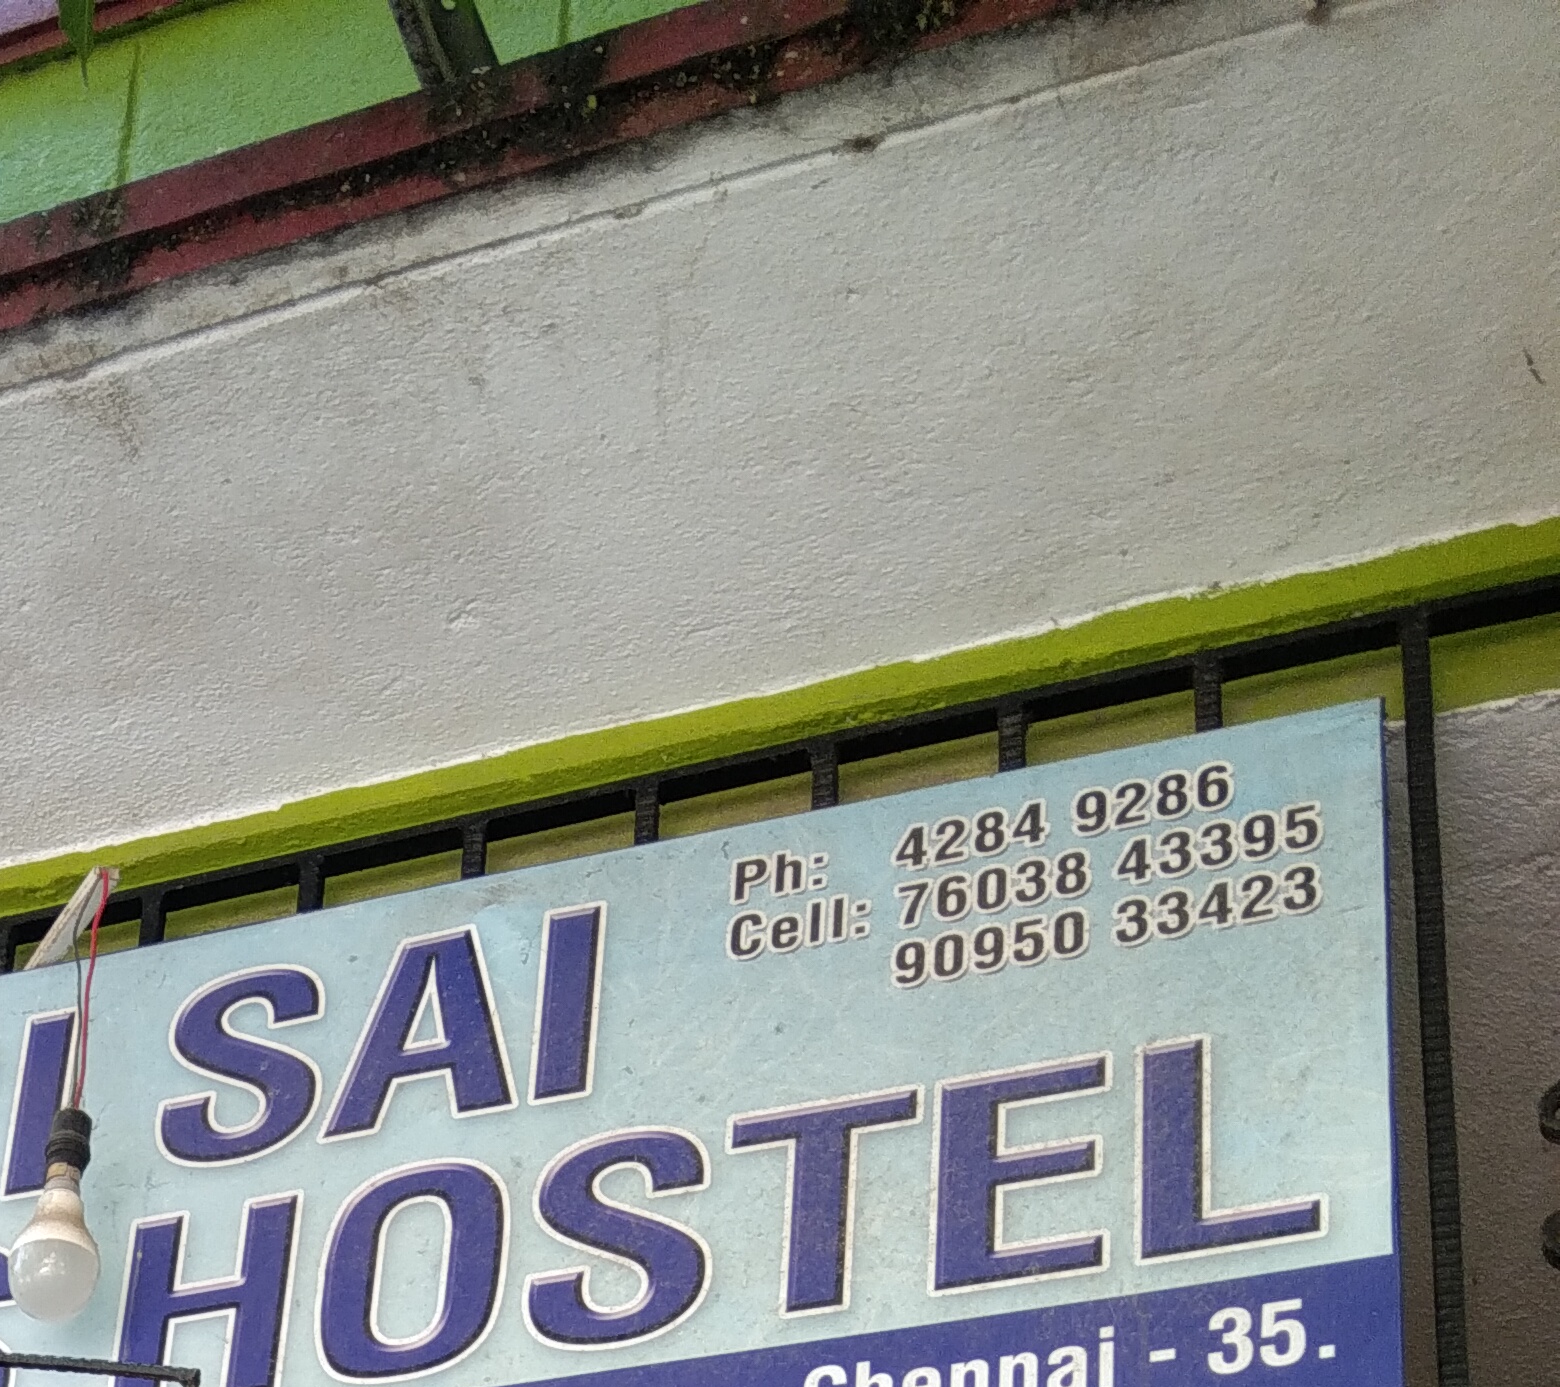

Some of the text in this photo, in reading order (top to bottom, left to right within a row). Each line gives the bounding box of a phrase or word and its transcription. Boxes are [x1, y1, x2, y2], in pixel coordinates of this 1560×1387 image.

[727, 804, 1321, 959] Cell: 76038 43395
[732, 762, 1232, 903] Ph: 4284 9286
[893, 866, 1321, 987] 90950 33423
[155, 901, 608, 1168] SAI
[1149, 1347, 1177, 1363] -
[1206, 1298, 1337, 1375] 35.
